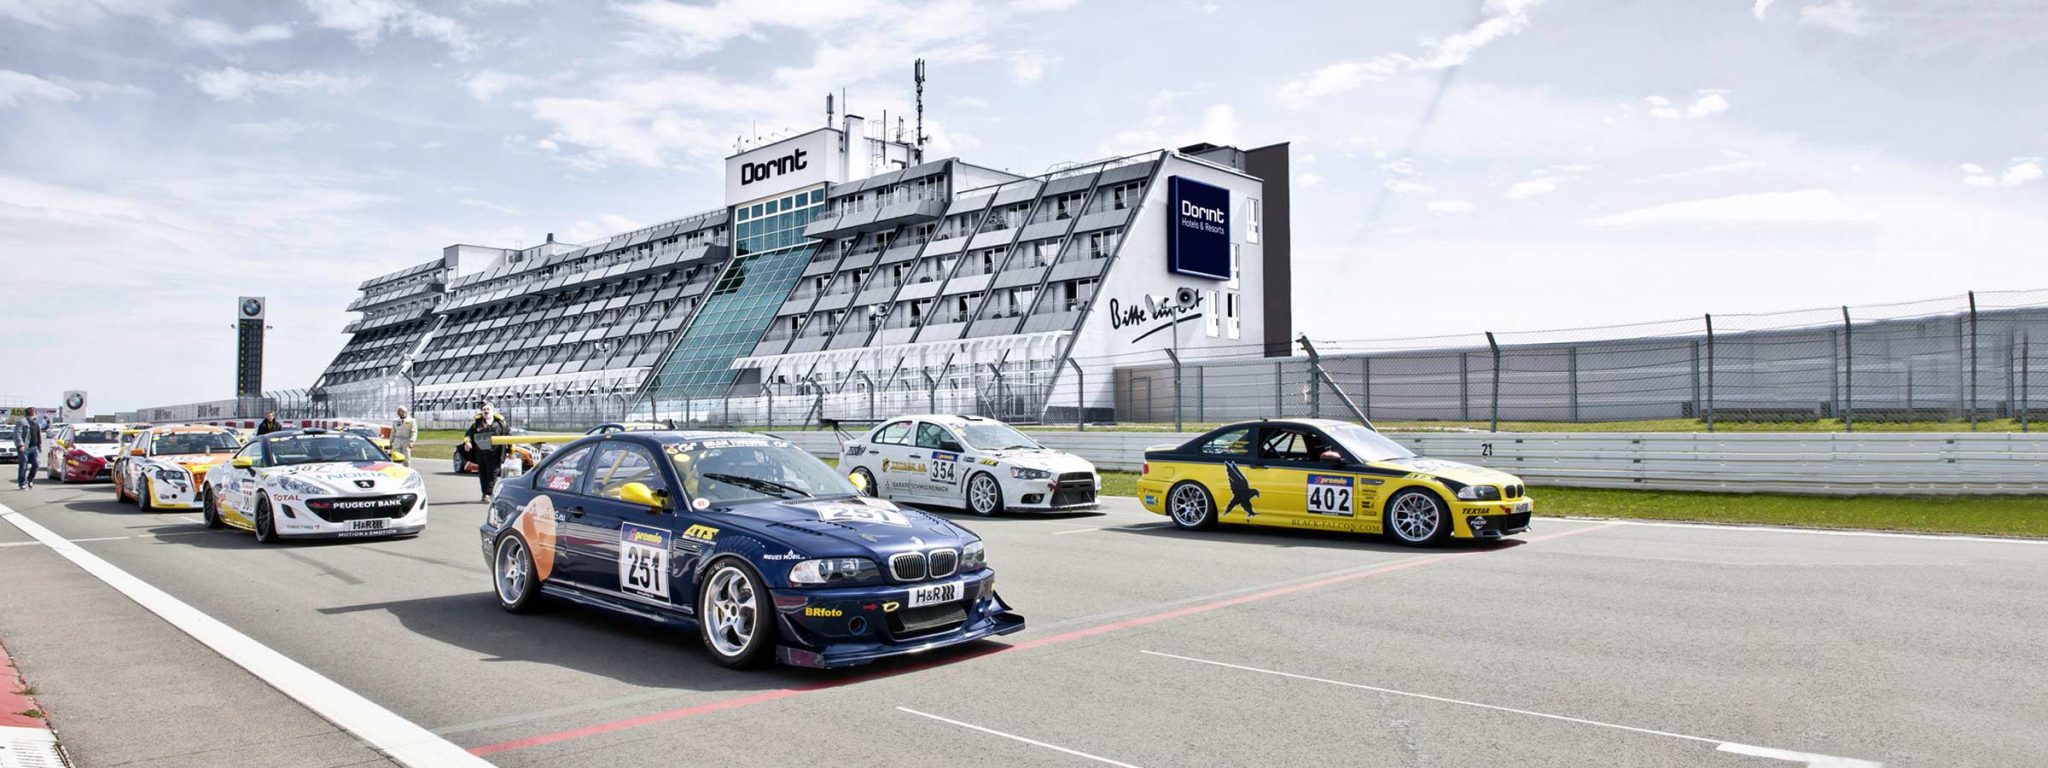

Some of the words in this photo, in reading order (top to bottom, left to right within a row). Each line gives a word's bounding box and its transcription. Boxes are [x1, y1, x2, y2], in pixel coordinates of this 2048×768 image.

[741, 148, 807, 186] Dorint
[1182, 200, 1225, 224] Dorint
[1182, 217, 1199, 230] Hotels
[1199, 221, 1205, 231] &
[1205, 222, 1225, 235] Resorts
[1110, 298, 1147, 330] Bitte
[1481, 443, 1493, 457] 21
[932, 460, 955, 480] 354
[272, 493, 301, 502] TOTAL
[333, 501, 376, 509] PEUGEOT
[378, 499, 402, 507] BANK
[1309, 486, 1351, 513] 402
[832, 507, 890, 521] 251
[1462, 507, 1491, 515] TEXTAR
[682, 524, 720, 541] ATS
[1291, 519, 1381, 533] BLACK-FALCON.COM
[628, 546, 661, 592] 251
[805, 607, 843, 617] BRfoto
